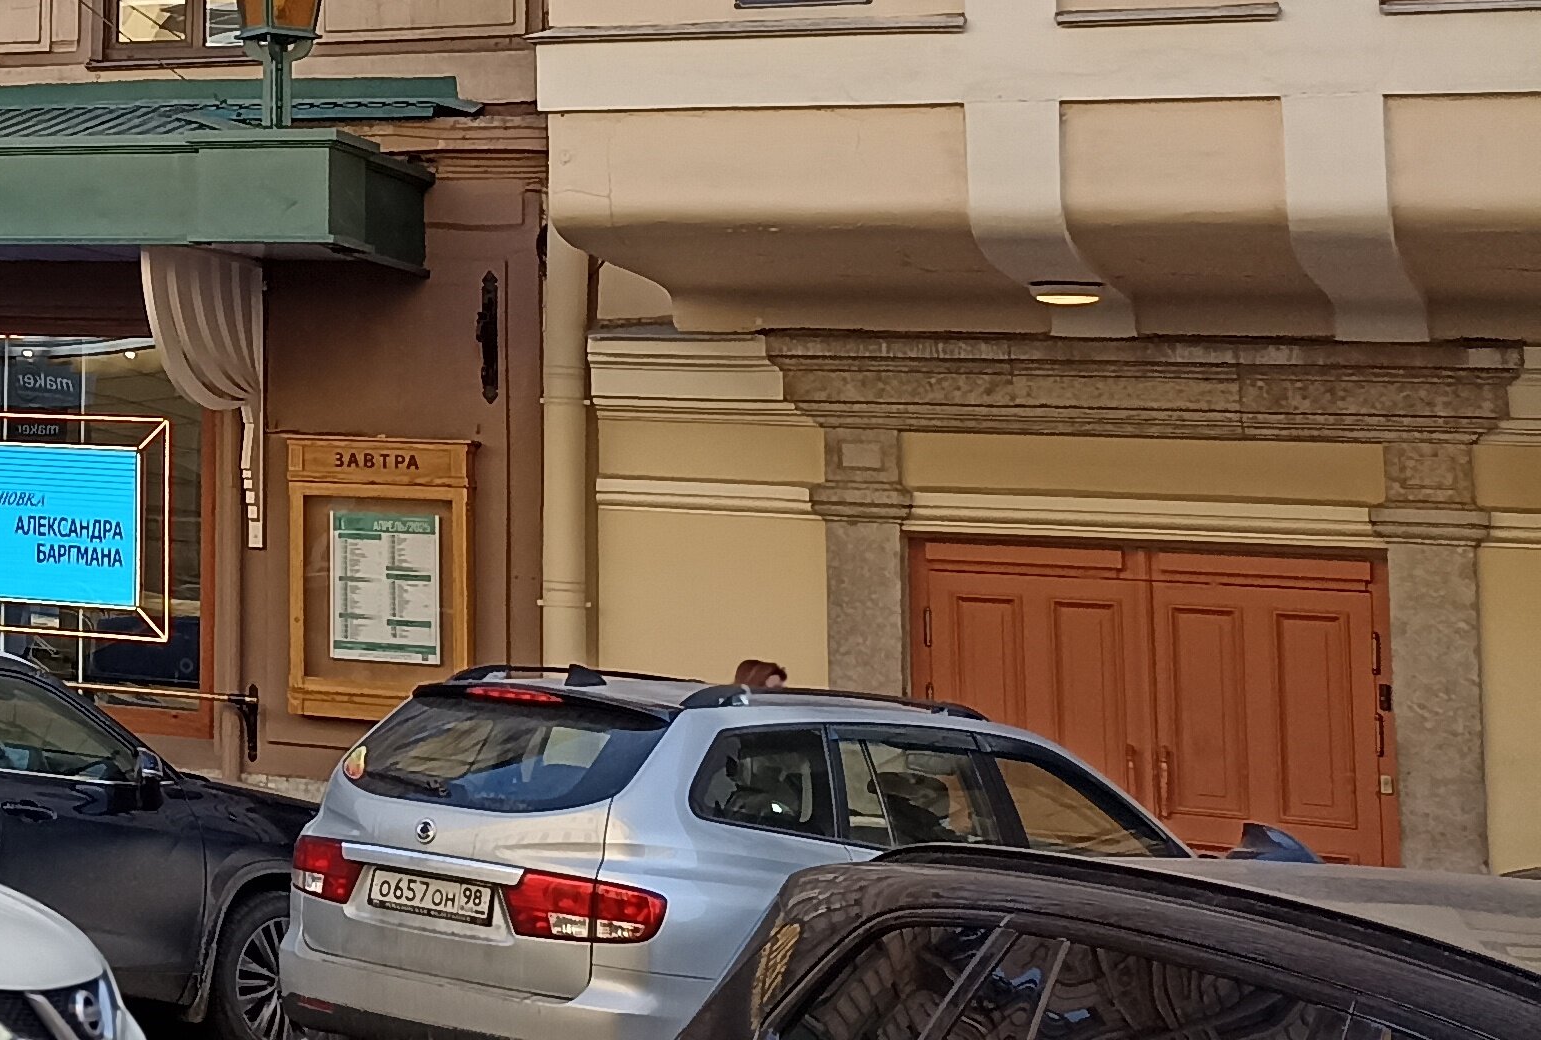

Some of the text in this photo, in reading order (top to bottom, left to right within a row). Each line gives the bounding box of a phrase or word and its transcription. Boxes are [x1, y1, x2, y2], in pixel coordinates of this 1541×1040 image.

[334, 452, 420, 471] ЗАВТРА
[15, 515, 124, 543] АЛЕКСАНДРА
[36, 542, 124, 568] БАРГМАНА
[462, 886, 483, 907] 98
